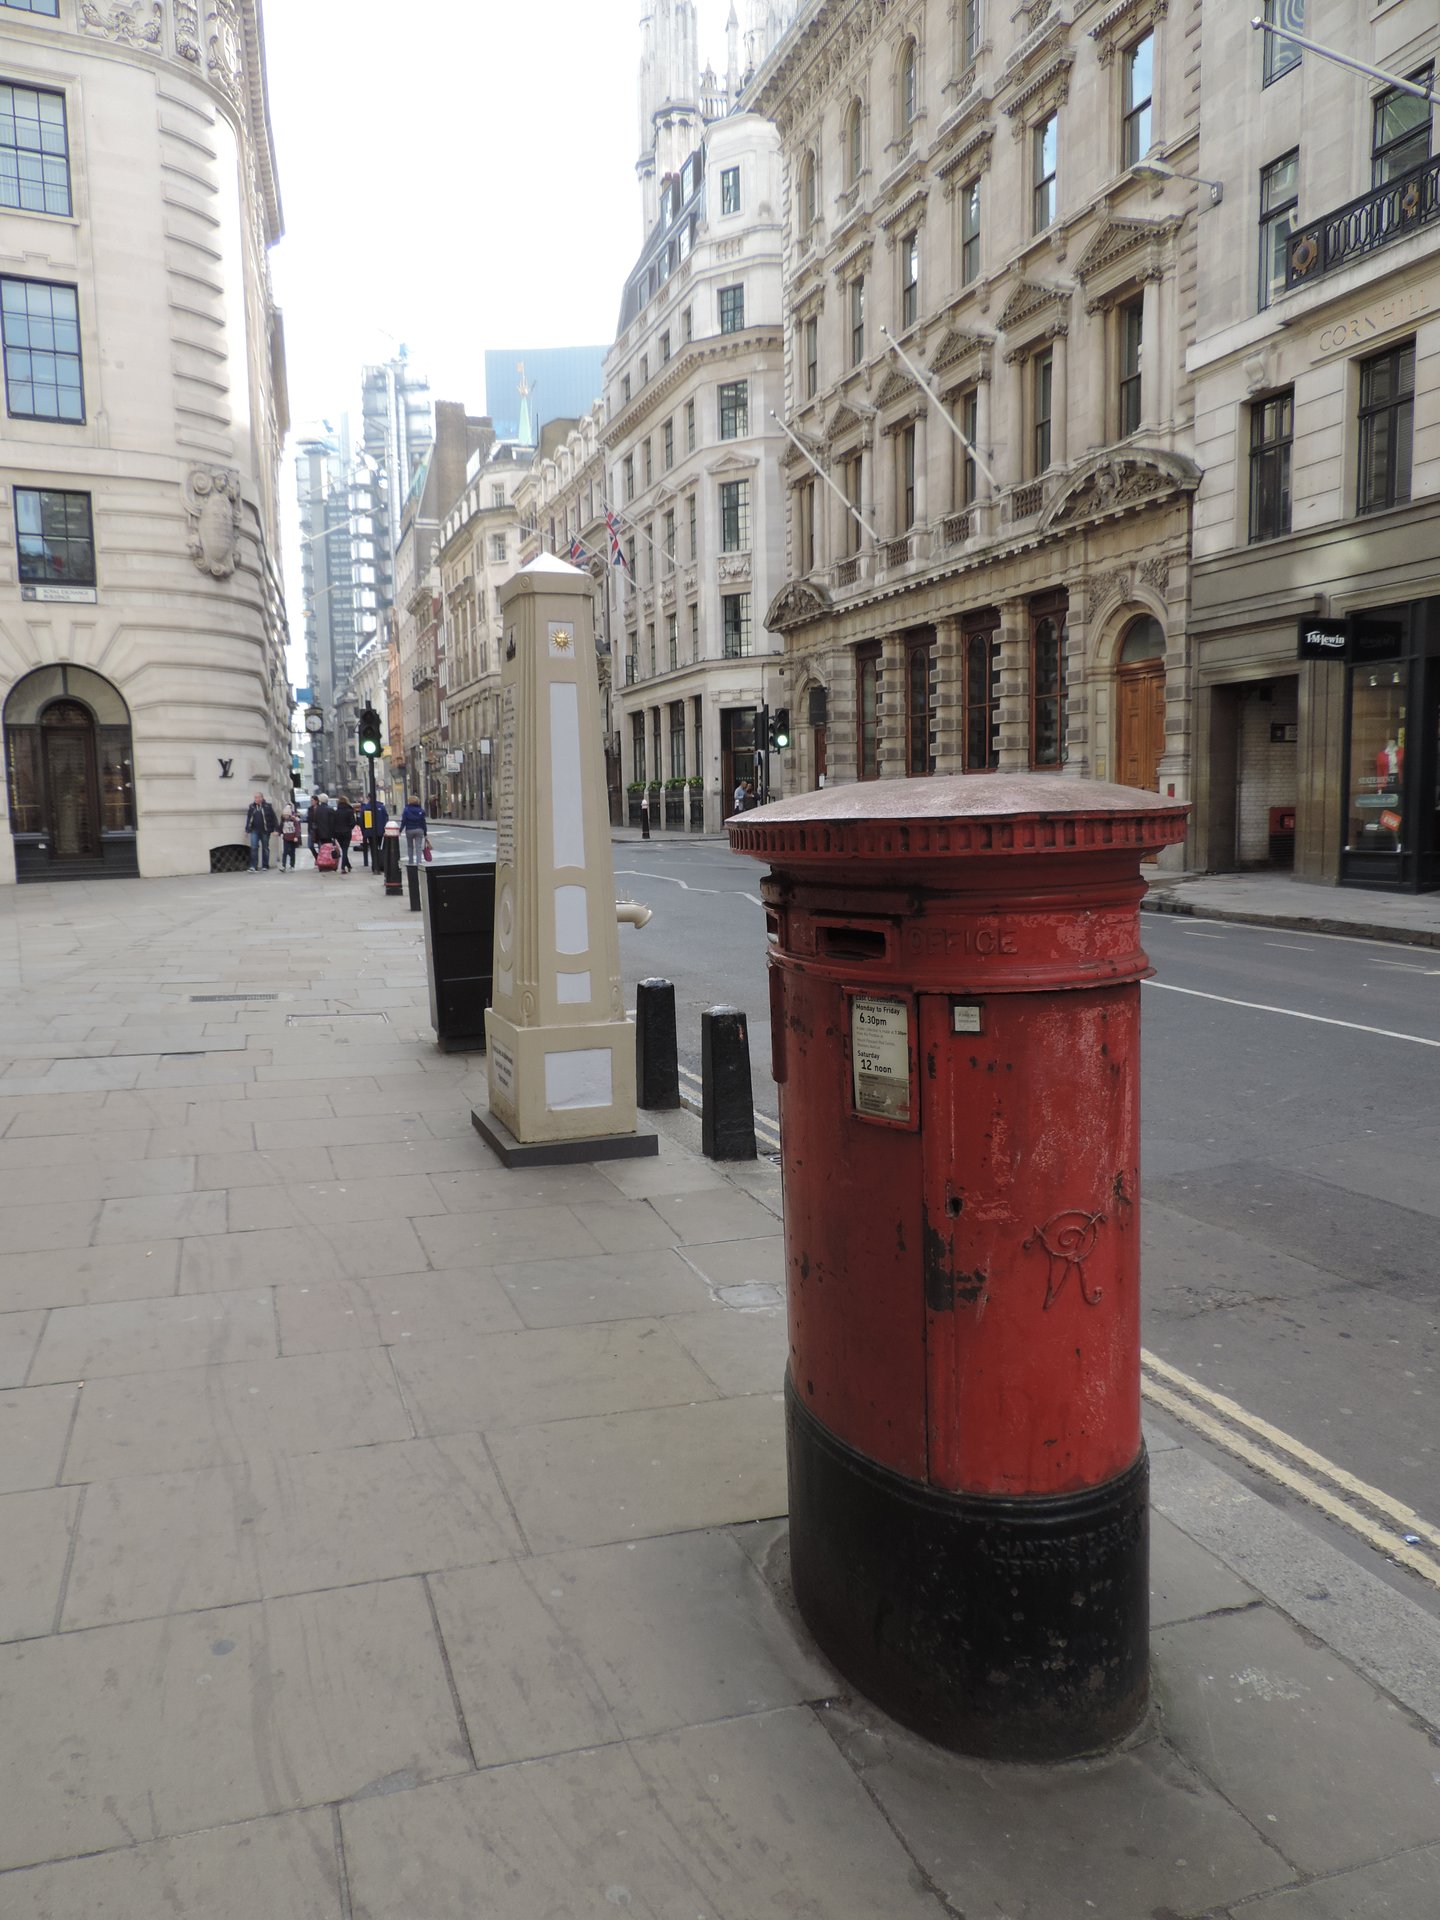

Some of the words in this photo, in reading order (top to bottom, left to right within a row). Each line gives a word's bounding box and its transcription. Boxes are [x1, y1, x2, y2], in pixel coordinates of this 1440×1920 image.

[1319, 288, 1431, 352] CORNHILL
[908, 926, 1019, 956] OFFICE
[855, 1003, 876, 1013] Monday
[883, 1007, 900, 1015] Friday
[860, 1013, 887, 1026] 6.30pm
[857, 1050, 880, 1060] Saturday
[861, 1059, 872, 1071] 12
[874, 1065, 892, 1074] noon
